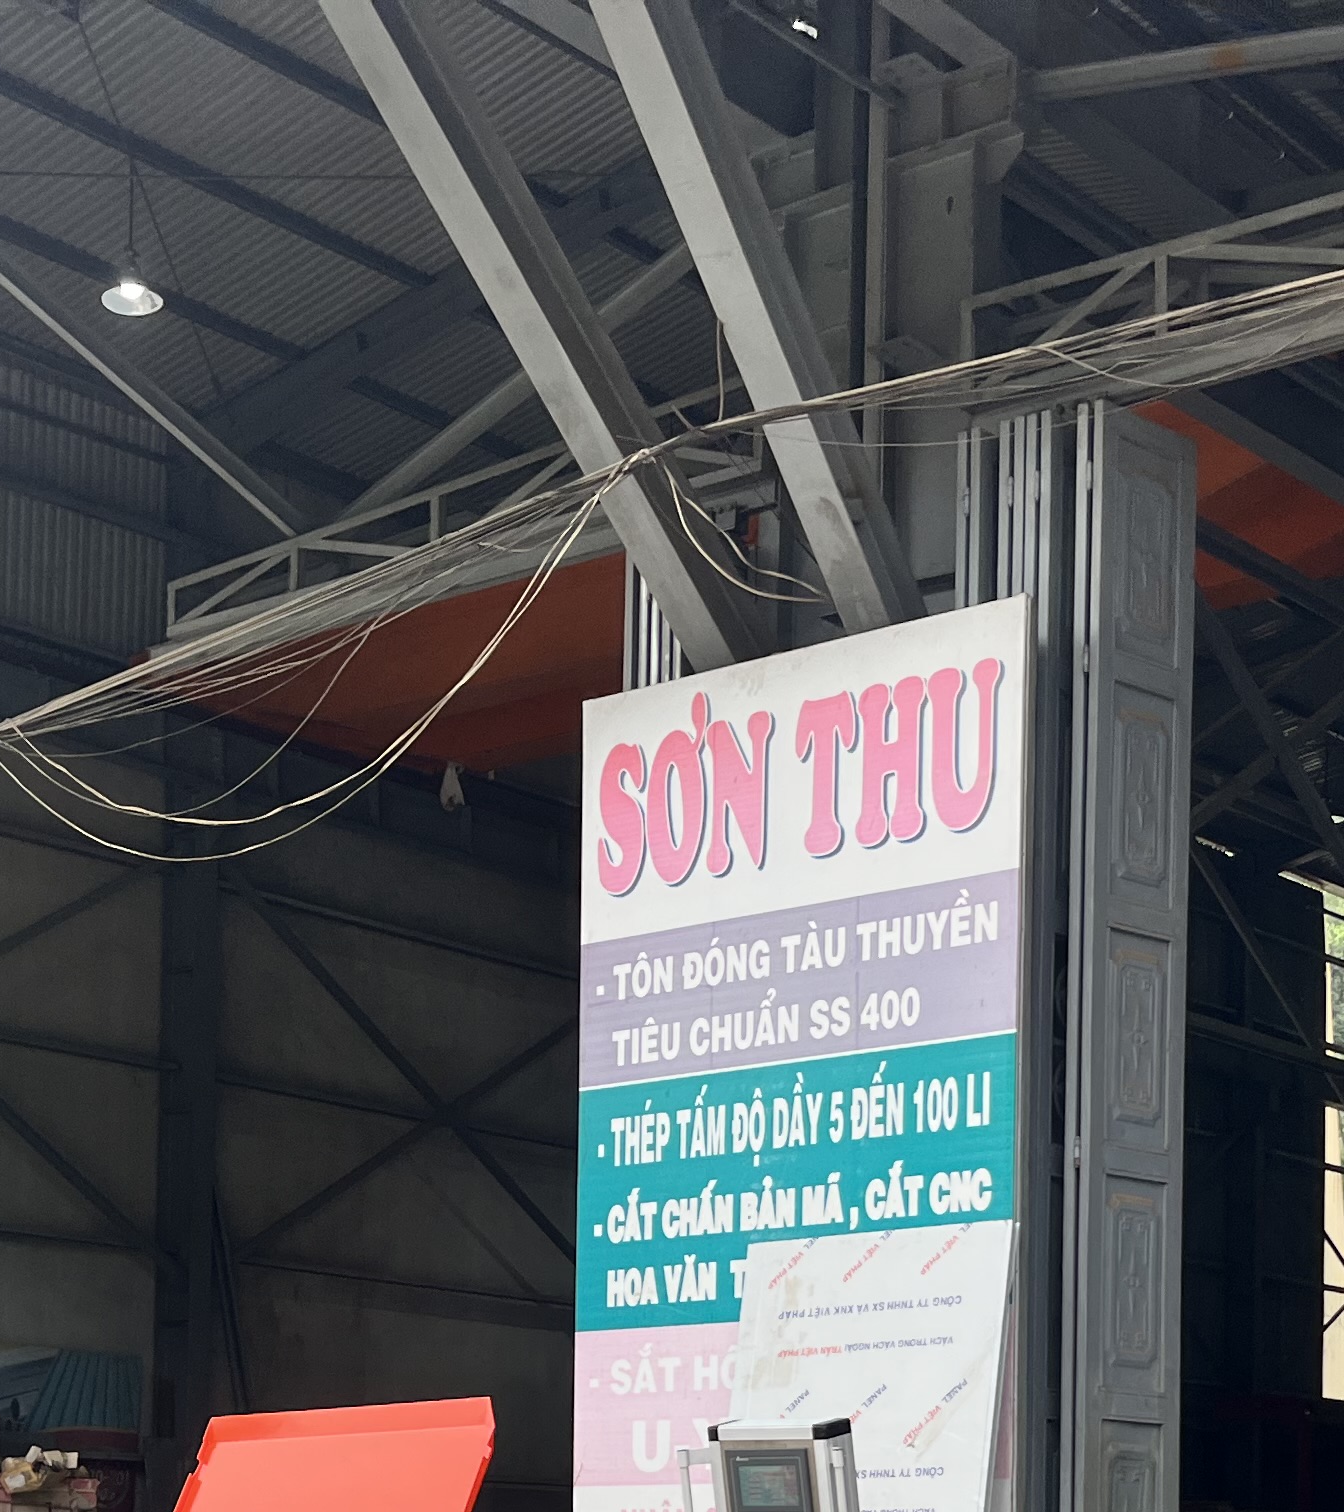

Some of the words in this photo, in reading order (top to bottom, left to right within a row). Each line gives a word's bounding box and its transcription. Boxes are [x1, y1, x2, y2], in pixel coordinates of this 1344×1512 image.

[597, 691, 775, 897] SƠN
[795, 657, 1005, 857] THU
[613, 952, 673, 1000] TÔN
[683, 938, 770, 990] ĐÓNG
[781, 922, 846, 973] TÀU
[856, 889, 998, 961] THUYỀN
[613, 1017, 680, 1067] TIÊU
[690, 989, 799, 1056] CHUẨN
[810, 996, 850, 1039] SS
[861, 987, 921, 1030] 400
[611, 1100, 669, 1166] THÉP
[676, 1085, 725, 1159] TẤM
[732, 1087, 765, 1166] ĐỘ
[774, 1072, 822, 1148] DẦY
[829, 1089, 843, 1144] 5
[851, 1062, 904, 1140] ĐẾN
[913, 1076, 958, 1133] 100
[967, 1071, 991, 1127] LI
[607, 1188, 657, 1244] CẮT
[662, 1180, 733, 1239] CHẤN
[740, 1175, 795, 1231] BẢN
[801, 1172, 844, 1225] MÃ
[865, 1160, 924, 1220] CẮT
[929, 1168, 993, 1213] CNC
[607, 1266, 659, 1307] HOA
[664, 1254, 716, 1303] VĂN
[872, 1303, 885, 1311] SX
[916, 1299, 929, 1307] TY
[933, 1295, 962, 1307] CÔNG
[610, 1343, 681, 1395] SẮT
[785, 1389, 810, 1413] PANEL
[861, 1384, 887, 1408] PANEL
[899, 1469, 911, 1477] TY
[916, 1467, 944, 1478] CÔNG
